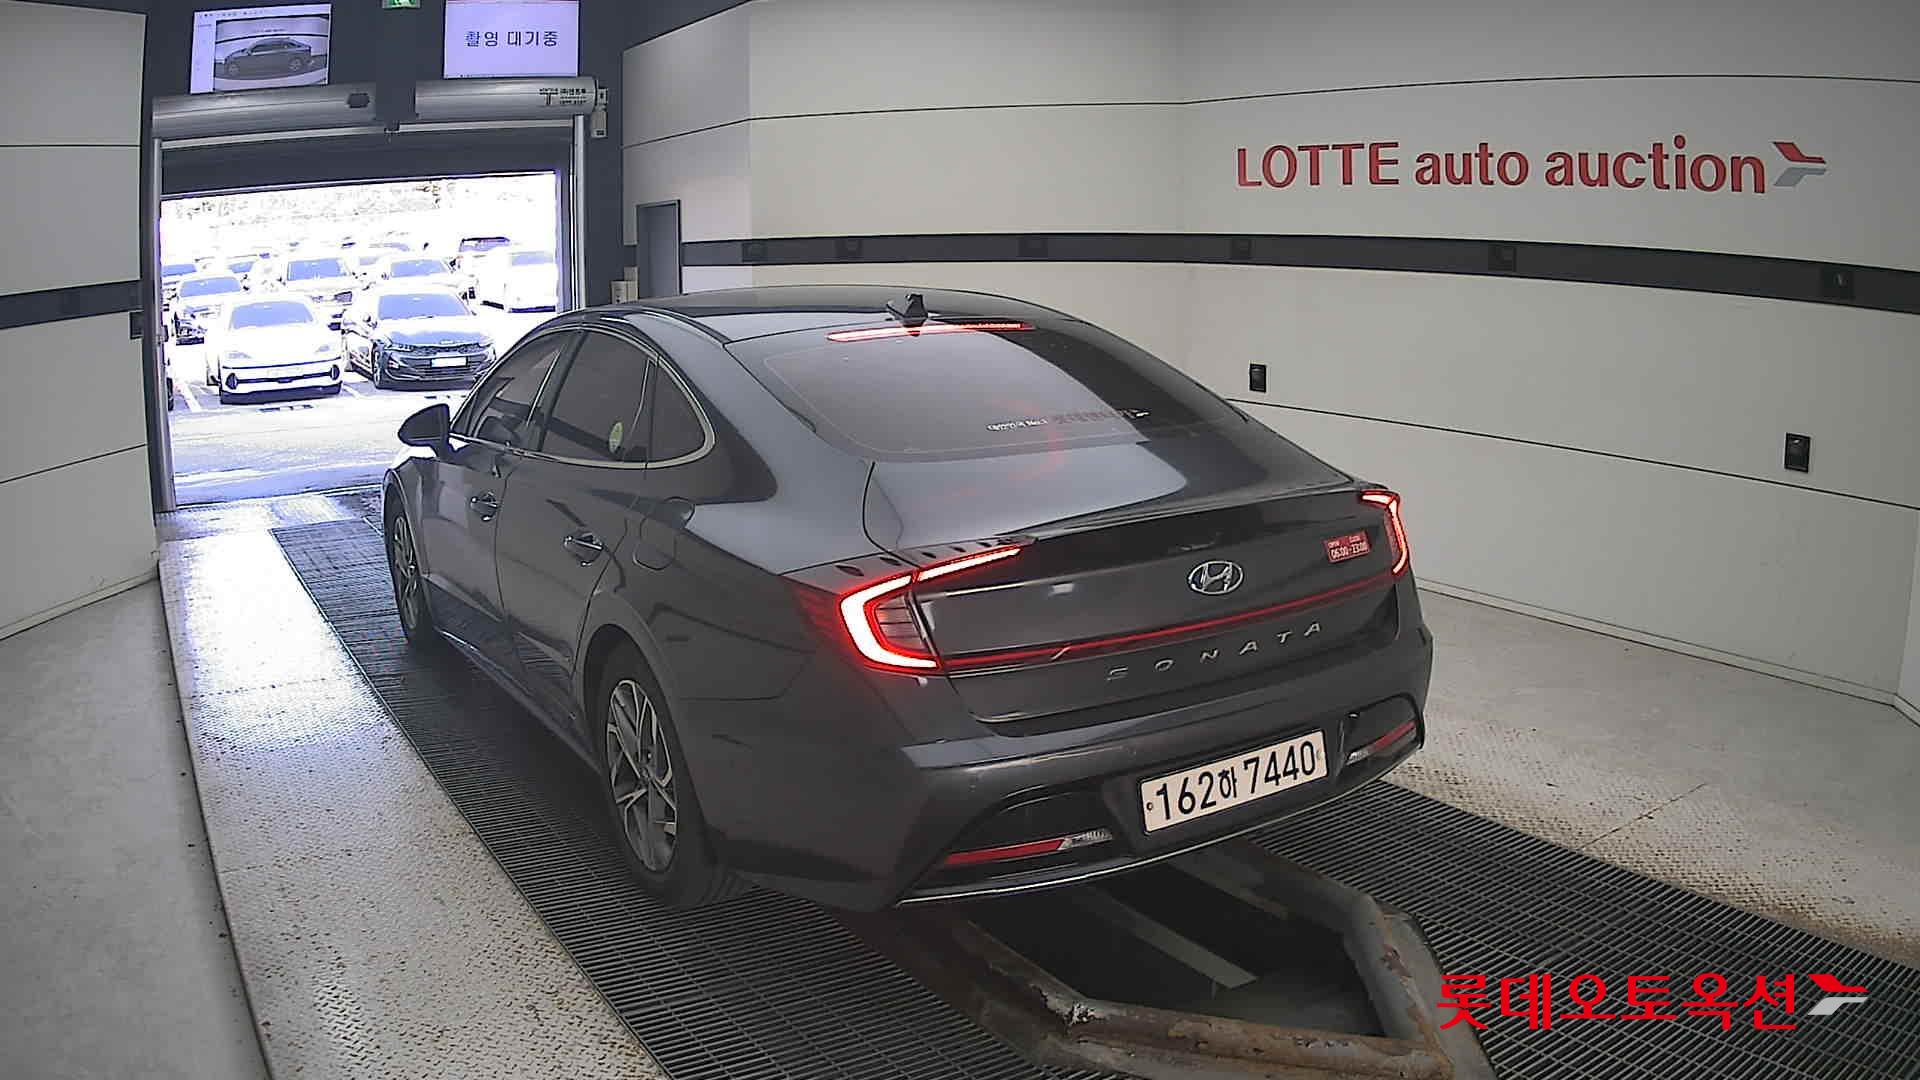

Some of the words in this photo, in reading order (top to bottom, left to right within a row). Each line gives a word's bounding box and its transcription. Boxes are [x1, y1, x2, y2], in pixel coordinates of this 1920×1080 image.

[507, 31, 558, 47] 대기중
[1237, 141, 1400, 188] LOTTE
[1414, 142, 1529, 187] auto
[1544, 135, 1766, 193] auction
[1107, 622, 1322, 681] SONATA
[1156, 766, 1238, 820] 162하
[1243, 741, 1316, 794] 7440
